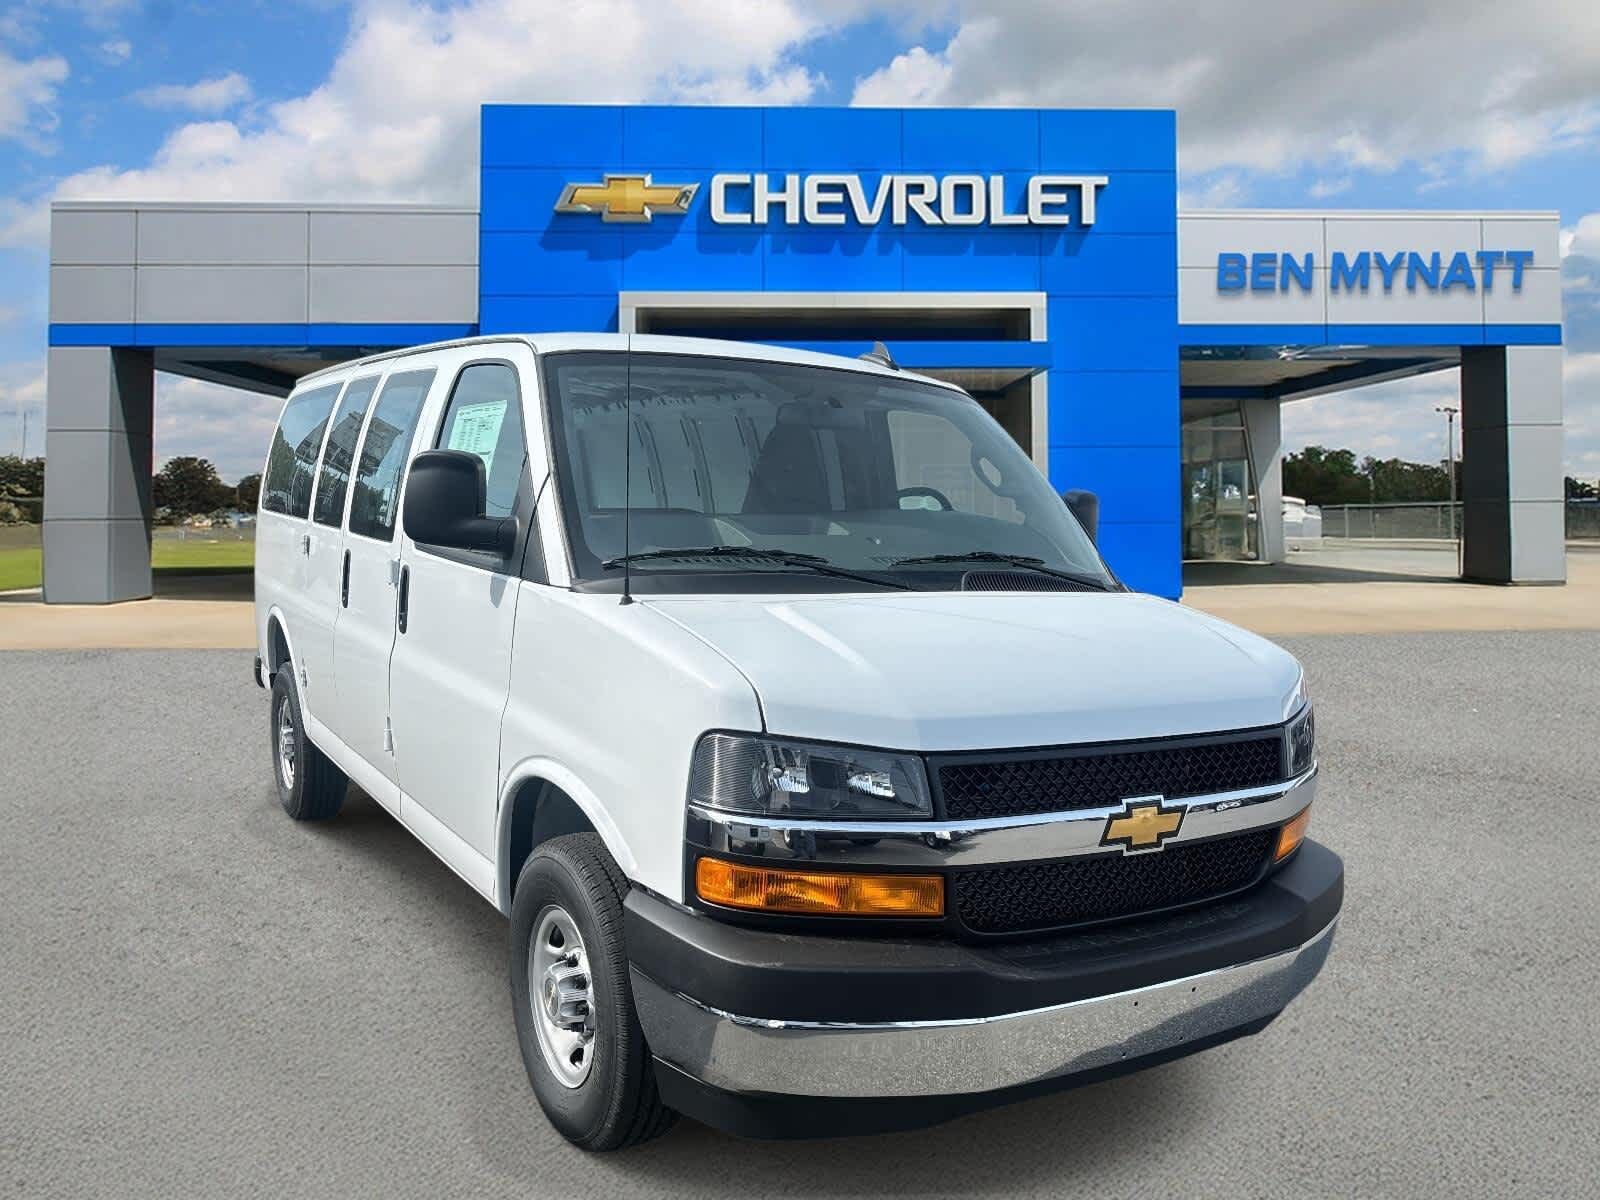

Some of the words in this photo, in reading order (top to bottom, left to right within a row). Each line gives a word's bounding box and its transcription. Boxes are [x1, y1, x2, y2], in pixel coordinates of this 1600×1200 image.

[711, 174, 1109, 225] CHEVROLET
[1217, 252, 1314, 290] BEN
[1330, 251, 1534, 290] MYNATT
